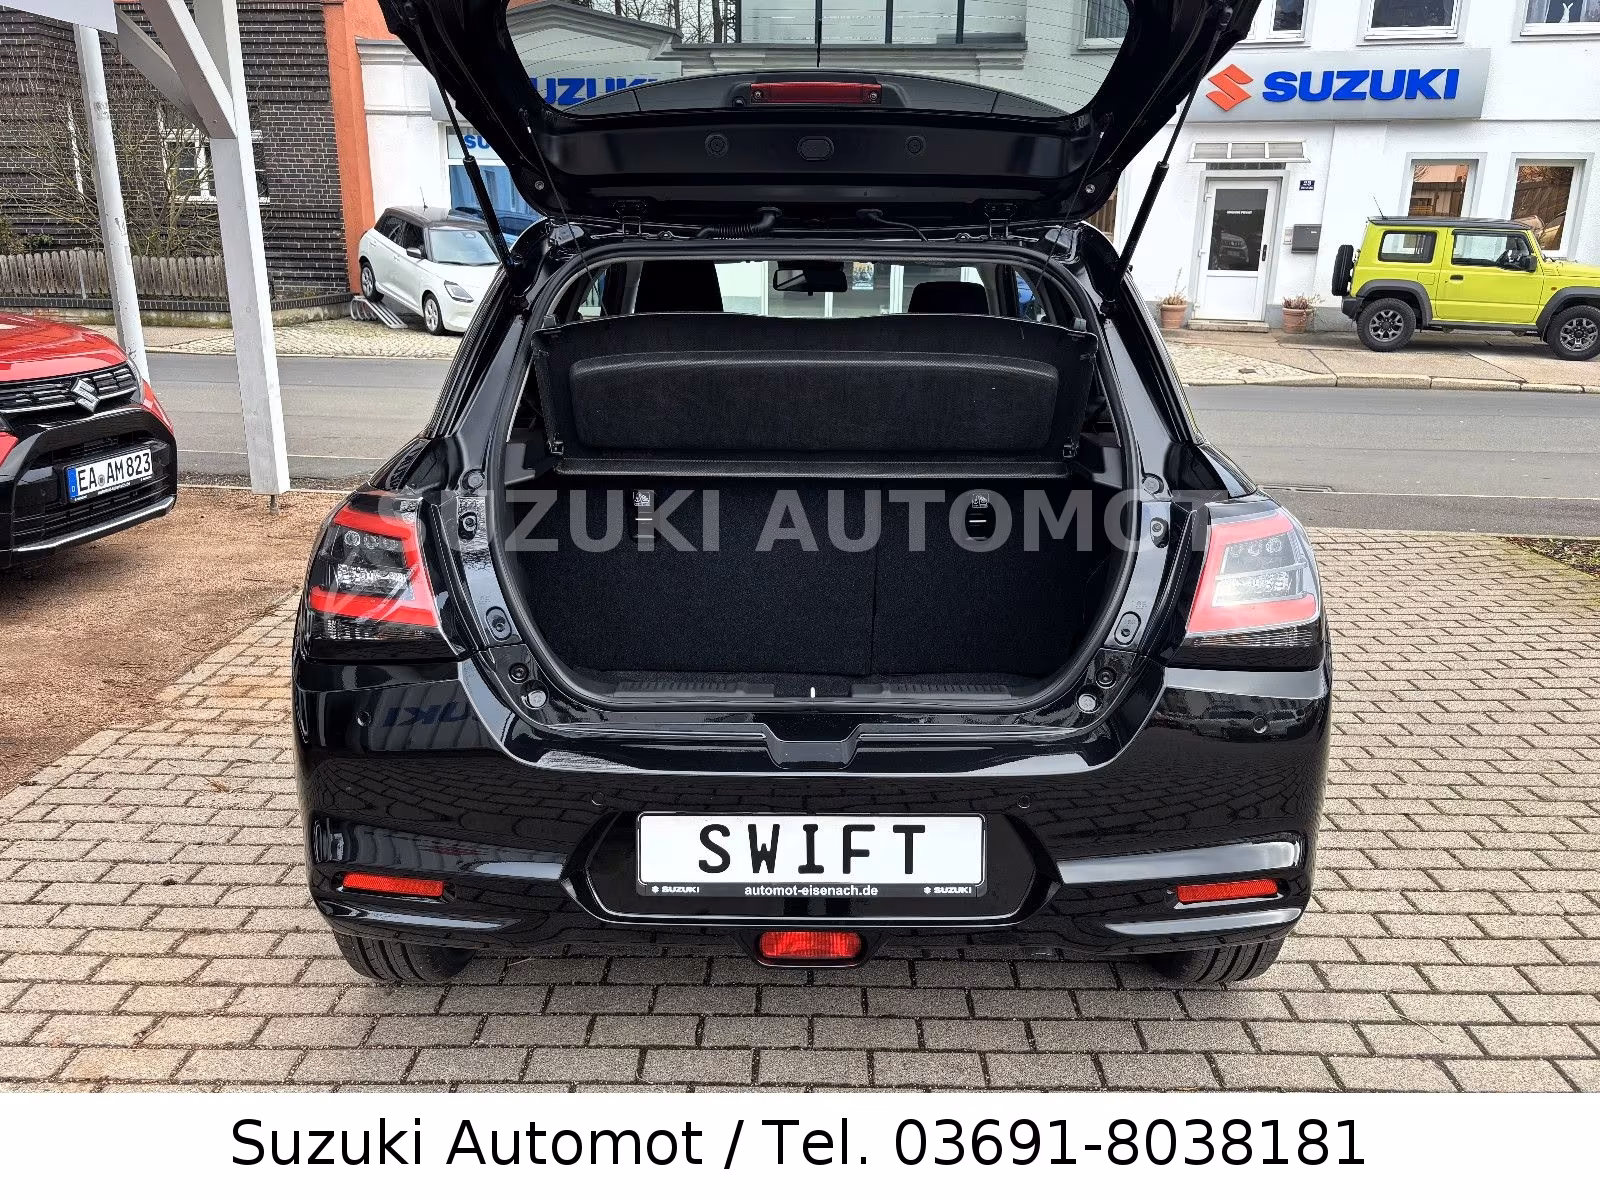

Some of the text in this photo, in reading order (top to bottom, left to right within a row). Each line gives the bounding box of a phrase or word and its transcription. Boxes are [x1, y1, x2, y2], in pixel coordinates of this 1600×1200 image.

[529, 77, 658, 105] UZU
[1262, 69, 1460, 102] SUZUKI
[78, 468, 97, 492] EA
[107, 459, 125, 483] AM
[126, 452, 151, 477] 823
[698, 823, 926, 875] SWIFT
[661, 885, 700, 894] SUZUKI
[744, 884, 879, 897] automot-eisenach.de
[933, 885, 972, 894] SUZUKI
